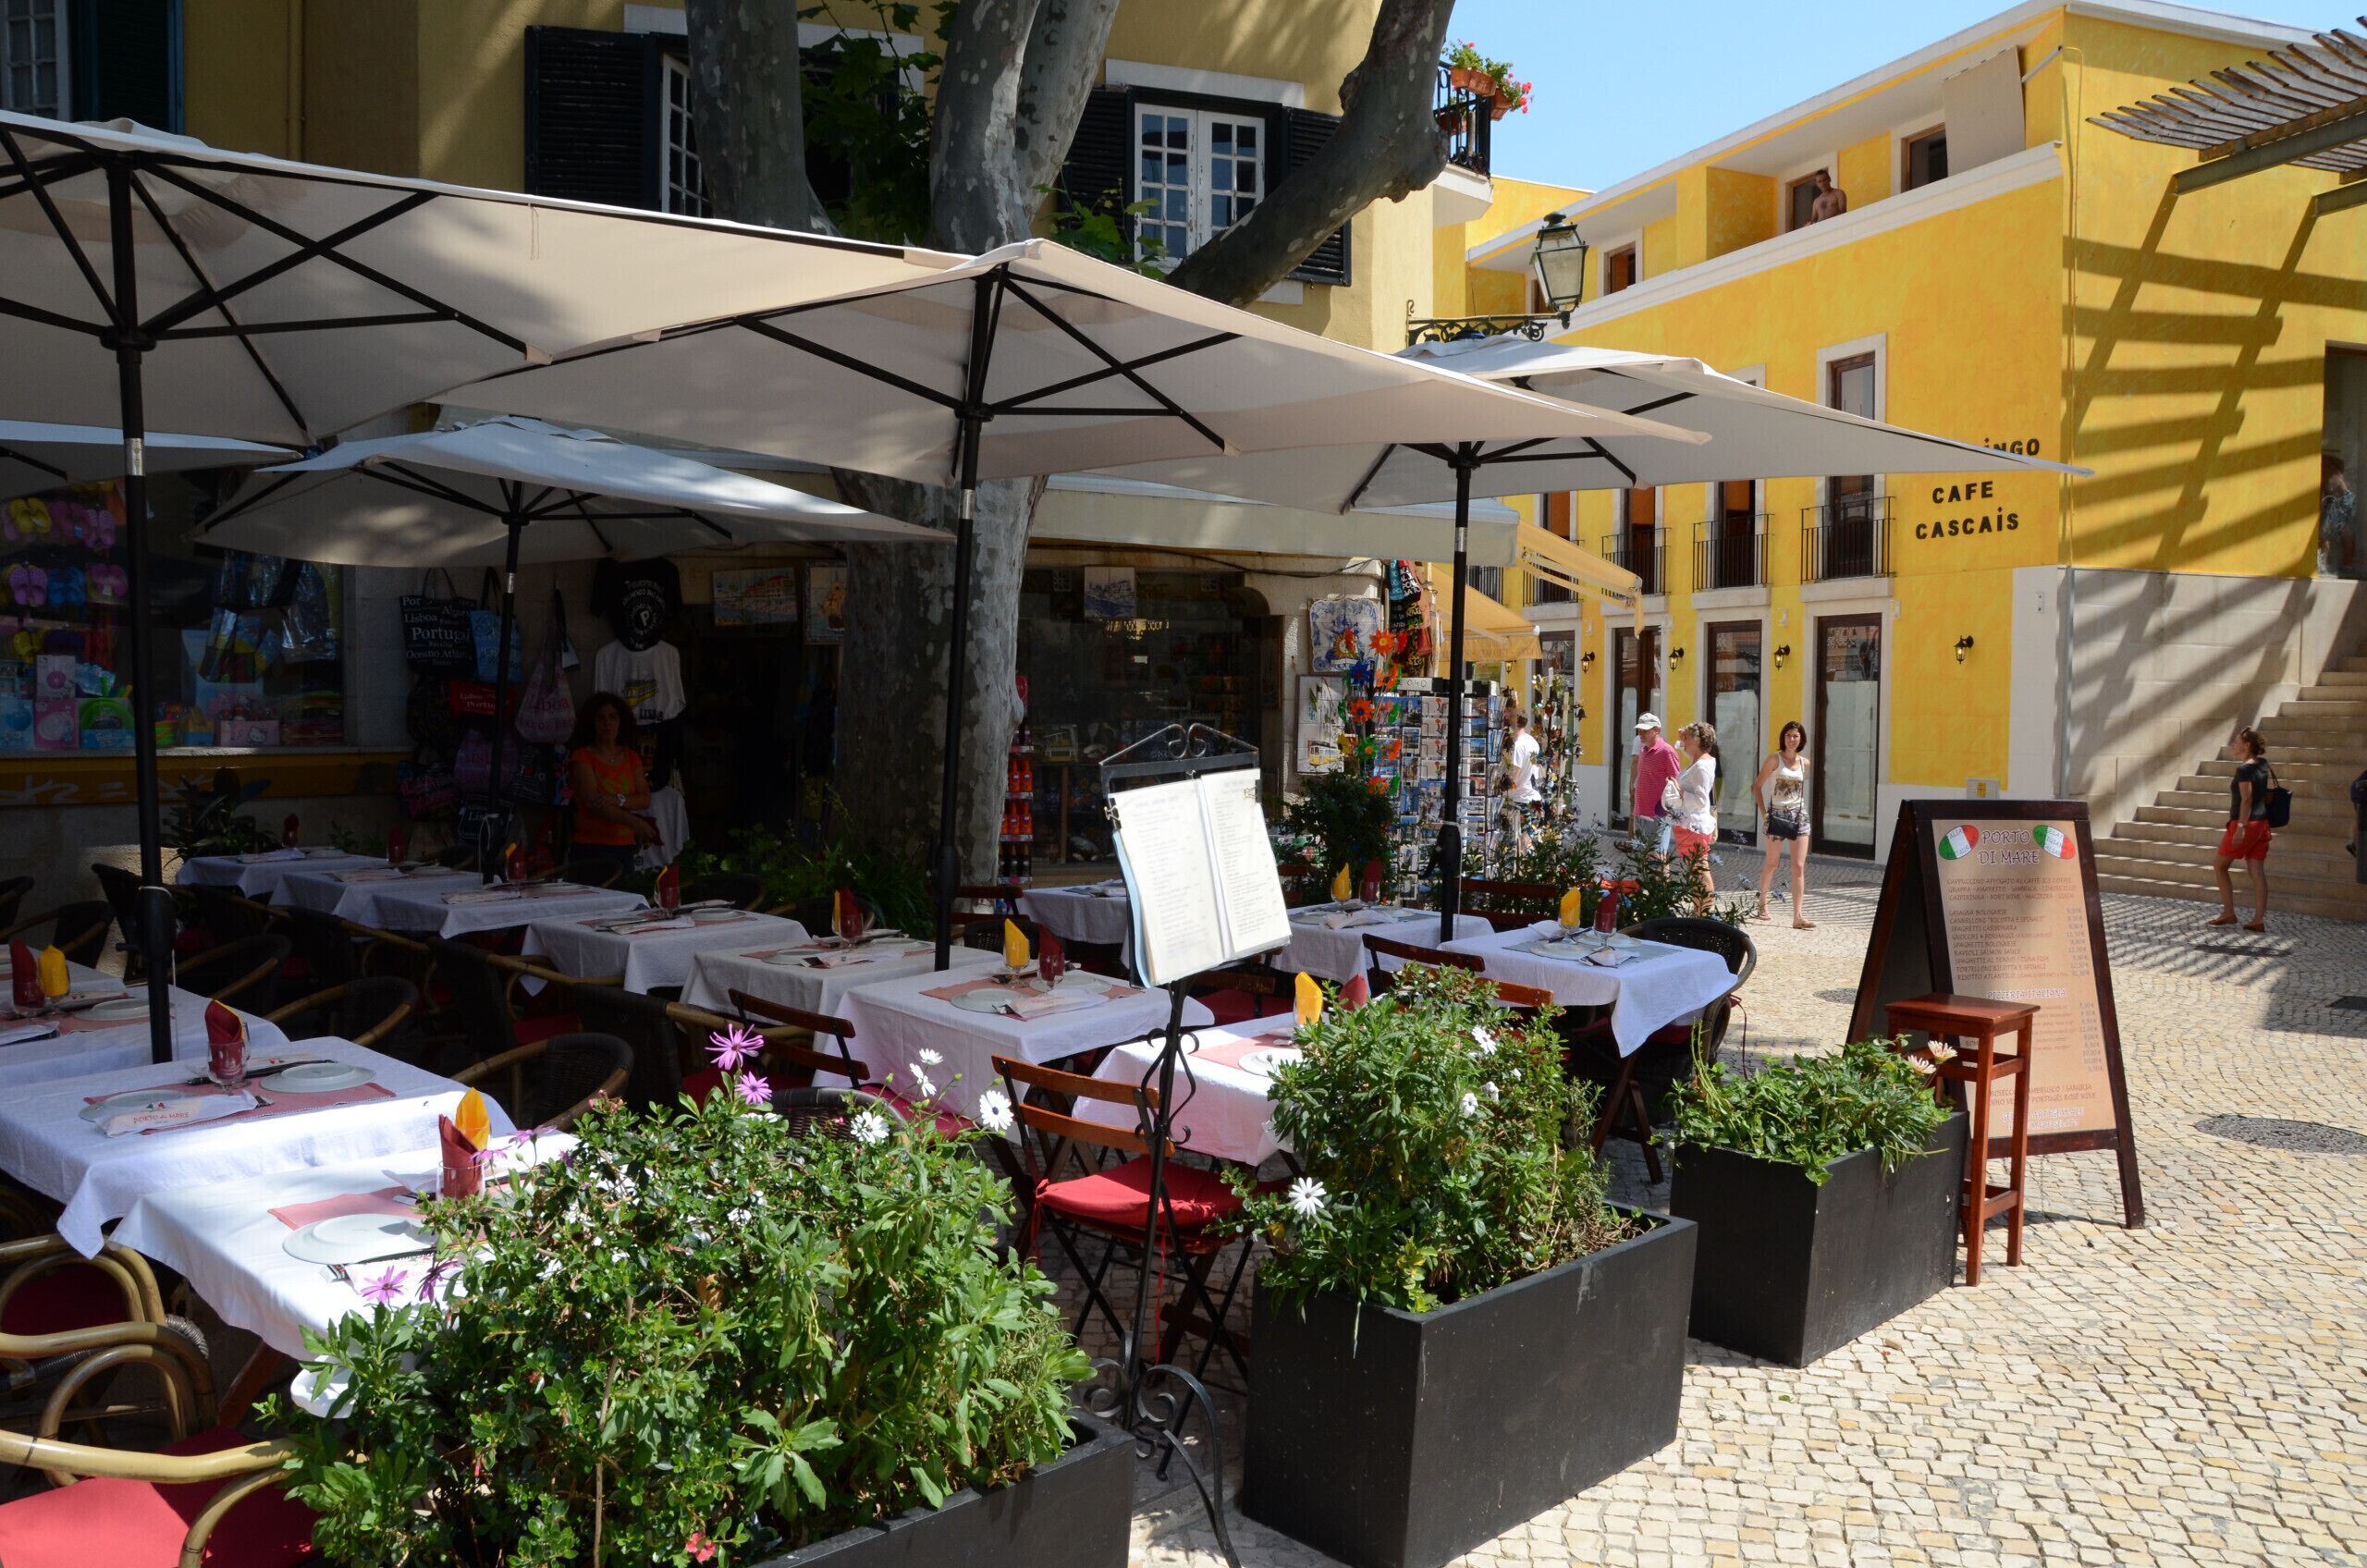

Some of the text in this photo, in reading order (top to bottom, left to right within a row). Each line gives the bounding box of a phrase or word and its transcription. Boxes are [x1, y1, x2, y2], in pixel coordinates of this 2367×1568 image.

[1932, 481, 1993, 504] CAFE
[404, 614, 438, 623] Lisboa
[1981, 829, 2031, 845] PORTO
[1978, 850, 2040, 864] DI MARE
[133, 1115, 157, 1124] PORTO
[169, 1111, 190, 1120] MARE
